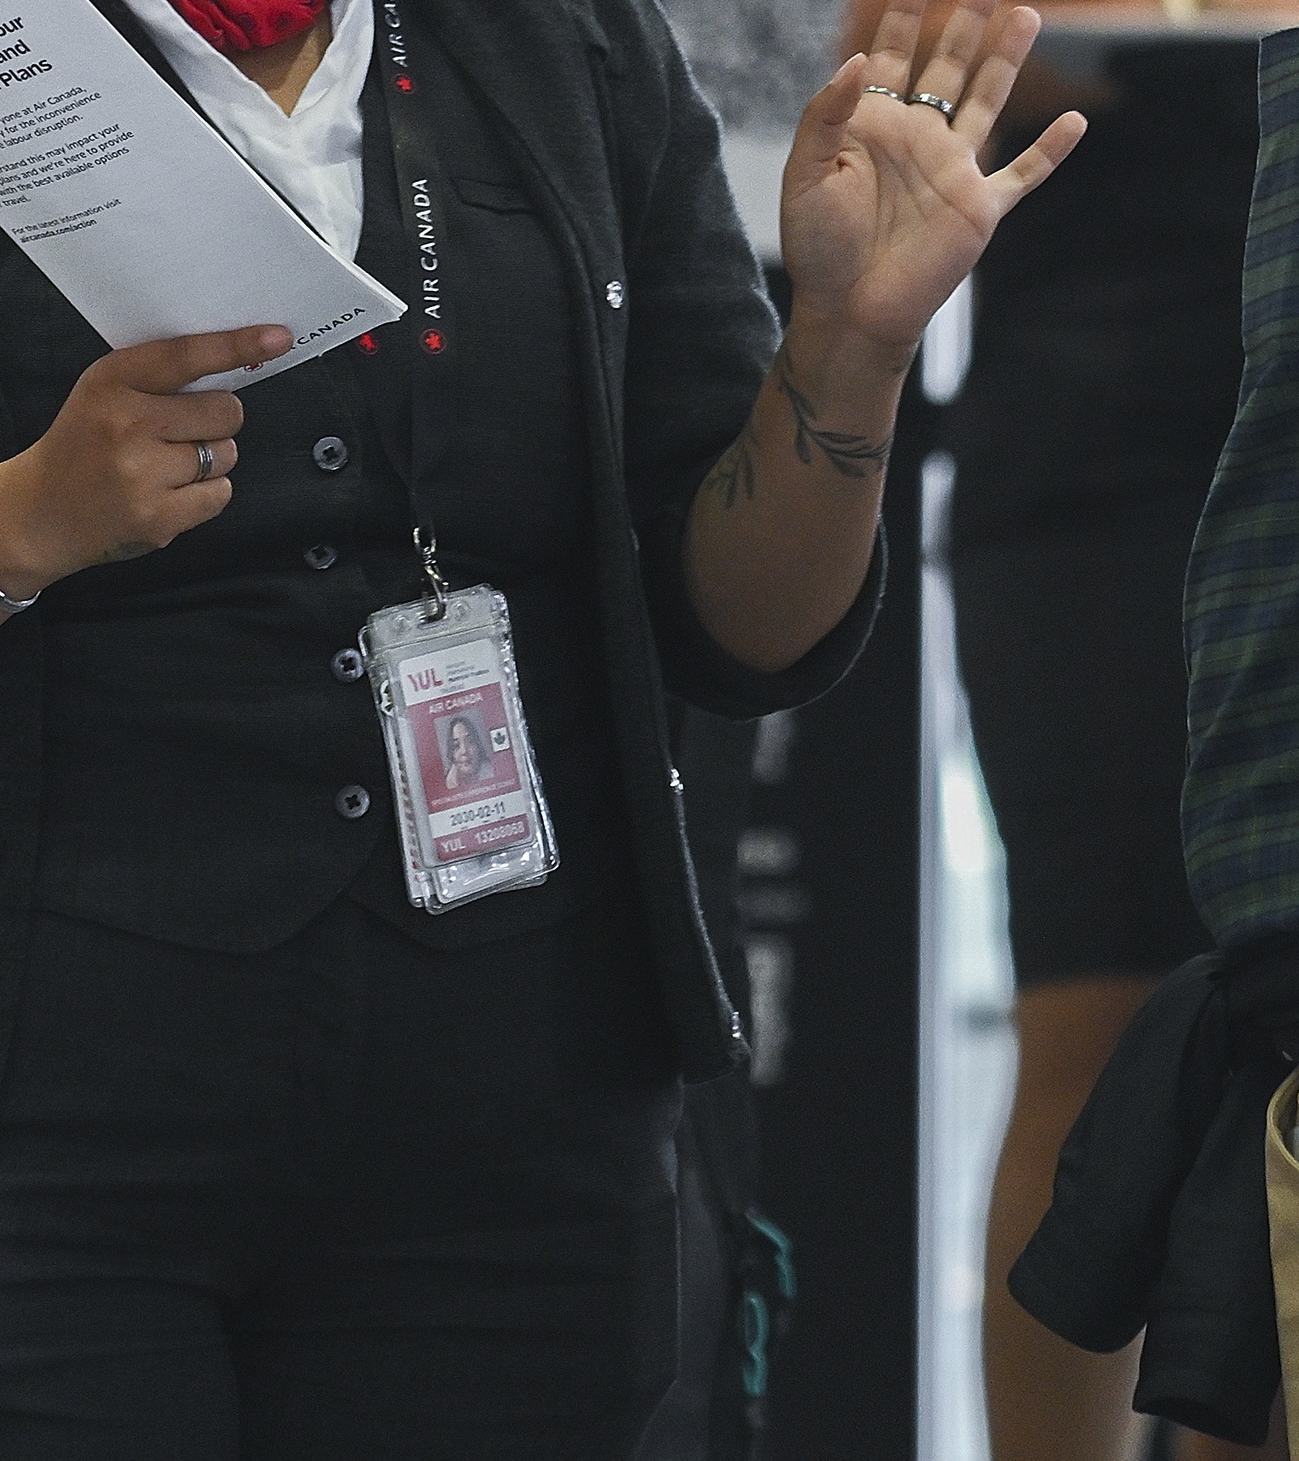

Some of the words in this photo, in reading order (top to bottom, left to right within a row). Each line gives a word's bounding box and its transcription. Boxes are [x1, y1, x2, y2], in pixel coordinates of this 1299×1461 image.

[388, 33, 408, 68] AIR
[33, 101, 47, 112] Air
[46, 86, 87, 105] Canada,
[34, 92, 102, 124] inconvenience
[2, 132, 33, 147] labour
[33, 114, 84, 137] disruption.
[26, 154, 46, 165] this
[45, 146, 66, 159] may
[64, 133, 99, 151] impact
[97, 123, 120, 139] your
[20, 167, 39, 179] and
[37, 160, 66, 173] we're
[62, 151, 87, 164] here
[97, 131, 135, 152] provide
[31, 176, 55, 188] best
[53, 162, 95, 181] available
[94, 147, 130, 166] options
[1, 194, 32, 207] travel.
[58, 205, 105, 224] information
[103, 198, 122, 209] visit
[411, 179, 438, 271] CANADA
[423, 279, 441, 319] AIR
[297, 307, 366, 345] CANADA
[445, 692, 483, 710] CANADA
[441, 838, 467, 853] YUL
